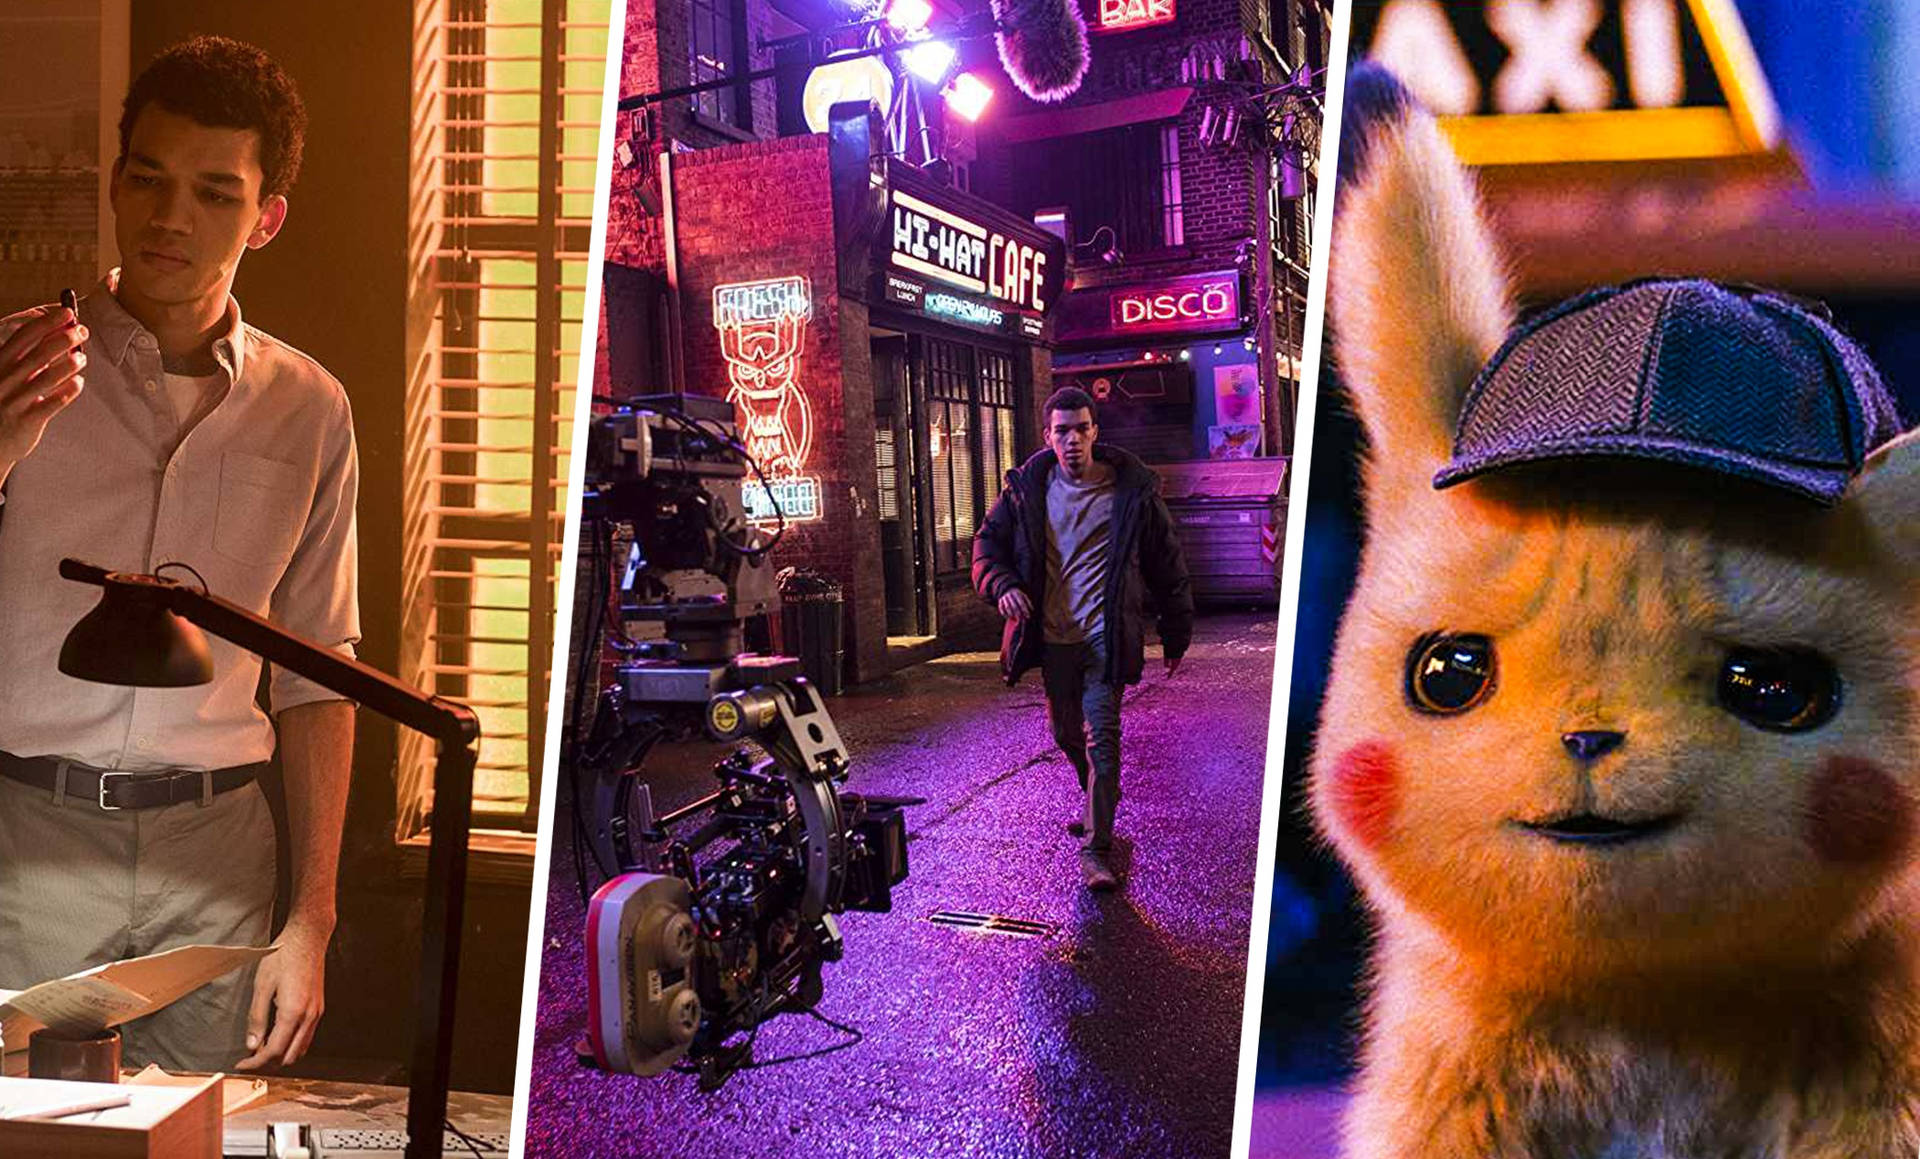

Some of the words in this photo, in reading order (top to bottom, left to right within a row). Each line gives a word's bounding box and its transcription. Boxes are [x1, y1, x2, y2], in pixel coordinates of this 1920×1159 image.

[1101, 0, 1171, 25] BAR
[989, 233, 1046, 312] CAFE
[1121, 289, 1228, 323] DISCO
